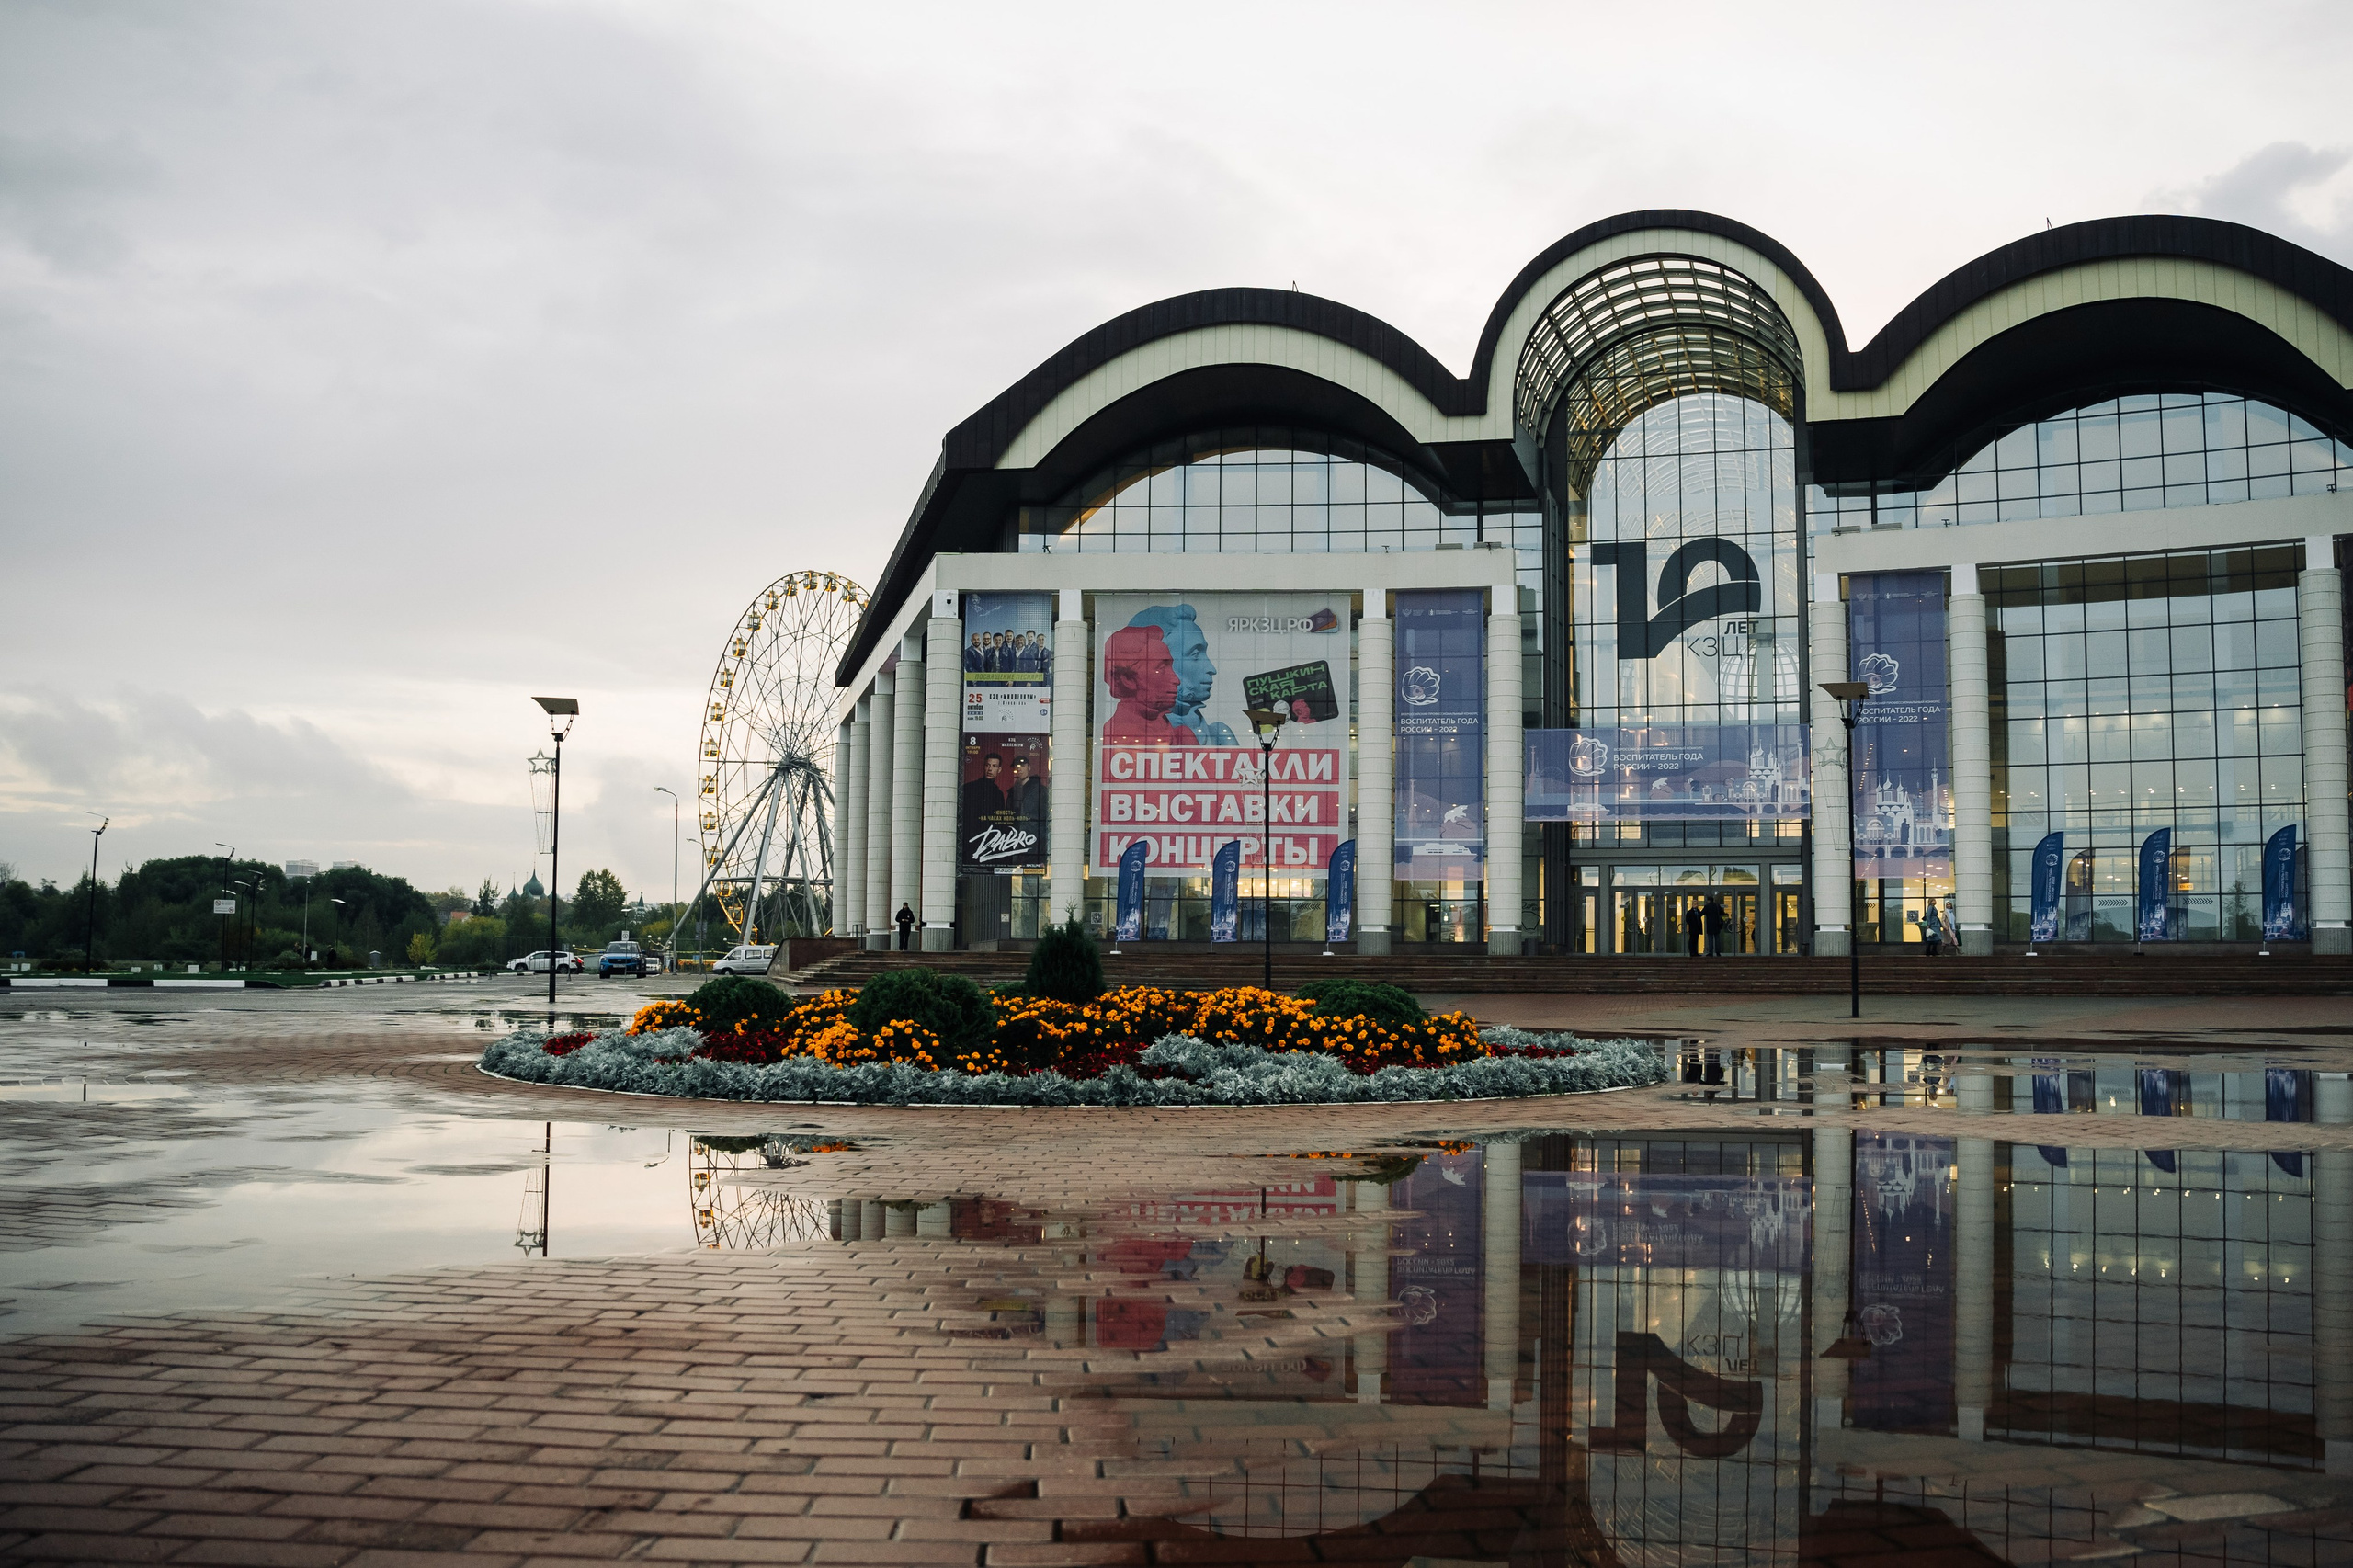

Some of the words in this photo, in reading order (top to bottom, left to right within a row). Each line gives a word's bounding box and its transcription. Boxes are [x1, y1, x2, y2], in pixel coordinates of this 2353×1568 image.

[1227, 617, 1313, 634] ЯРКЗЦ.РФ
[1724, 620, 1759, 634] ЛЕТ
[1687, 636, 1743, 660] КЗЦ
[1246, 664, 1325, 688] ПУШКИН
[1249, 679, 1296, 697] СКАЯ
[1270, 681, 1328, 699] КАРТА
[968, 693, 983, 703] 25
[970, 736, 977, 745] 8
[1110, 752, 1332, 780] СПЕКТАКЛИ
[1678, 753, 1704, 761] ГОДА
[1109, 793, 1319, 823] ВЫСТАВКИ
